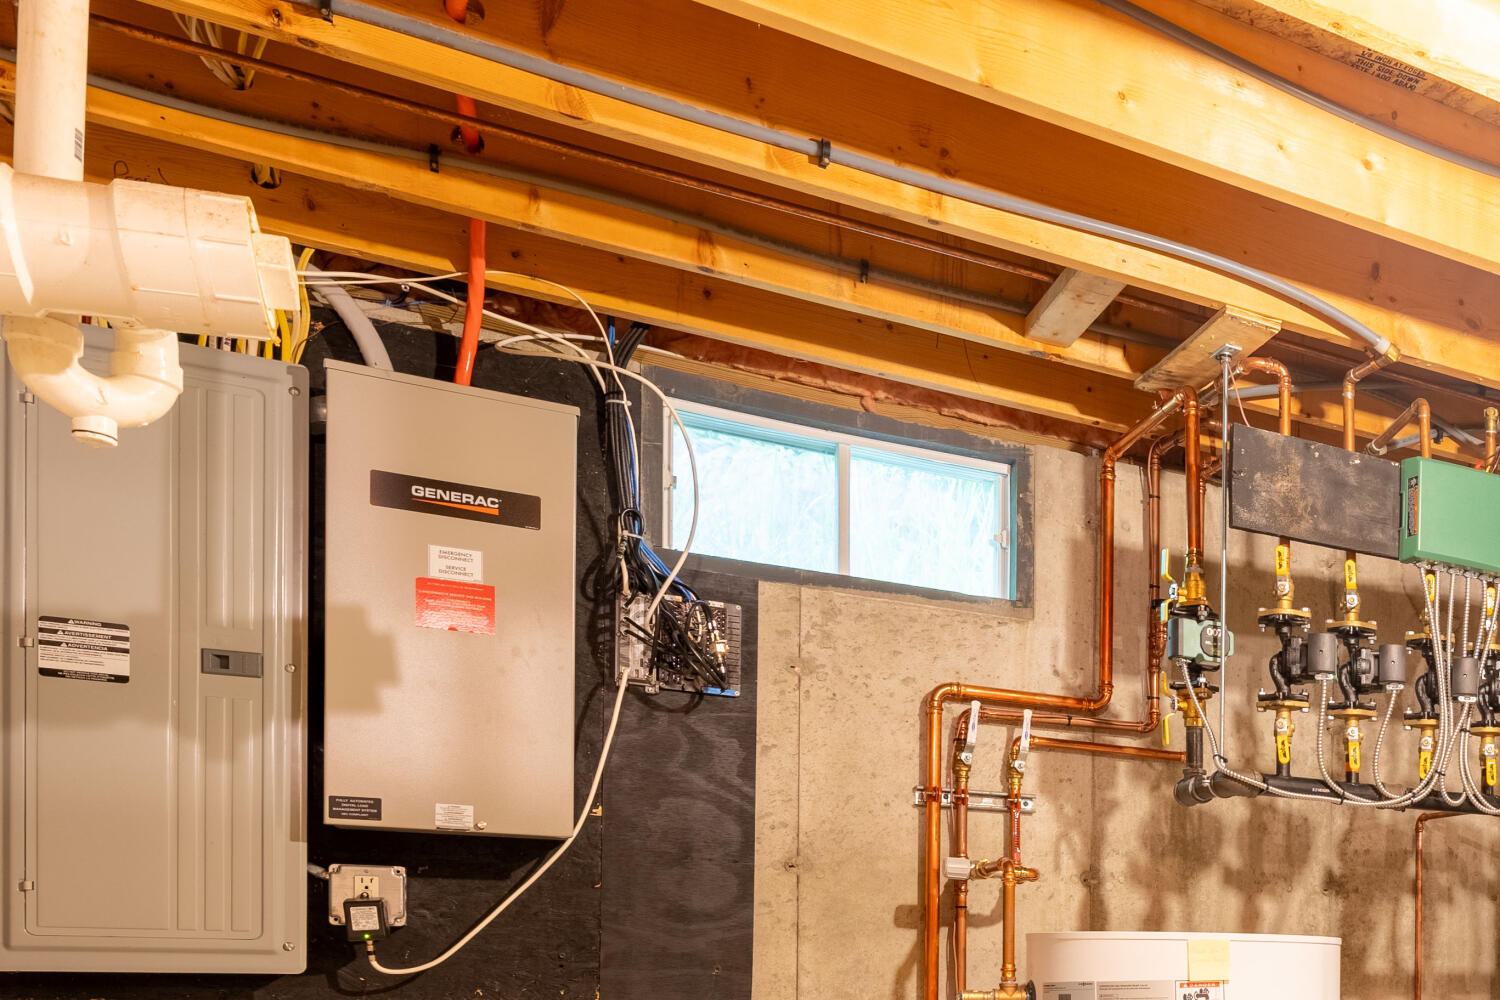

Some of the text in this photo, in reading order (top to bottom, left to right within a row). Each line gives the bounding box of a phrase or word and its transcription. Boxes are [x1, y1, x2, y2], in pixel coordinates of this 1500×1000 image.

[1356, 58, 1419, 84] THIS SIDE DOWN
[411, 485, 499, 508] GENERAC
[439, 549, 472, 558] EMERGENCY
[438, 555, 474, 563] DISCONNECT
[438, 568, 474, 577] DISCONNECT
